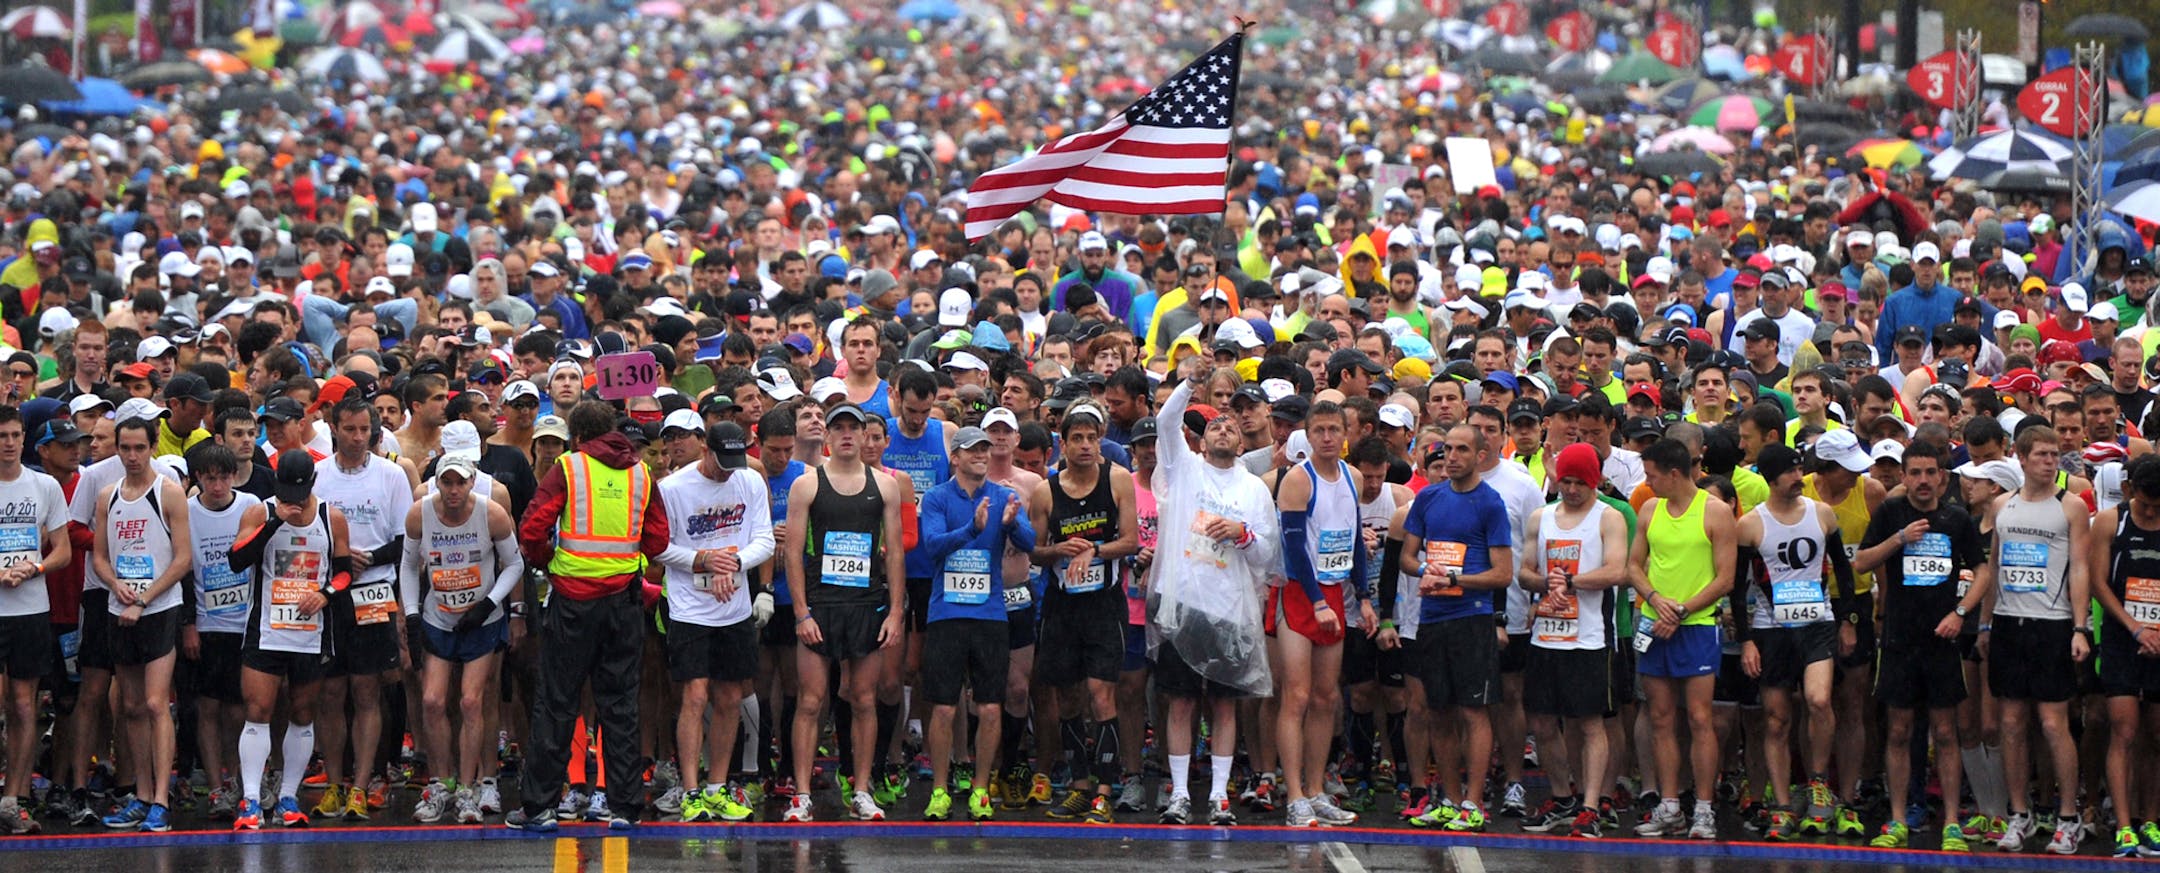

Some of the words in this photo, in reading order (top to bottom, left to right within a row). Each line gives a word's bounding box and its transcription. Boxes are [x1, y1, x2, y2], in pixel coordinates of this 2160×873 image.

[1927, 72, 1944, 99] 3
[2034, 81, 2068, 92] CORRAL
[2041, 93, 2060, 124] 2
[602, 363, 654, 388] 1:30
[115, 519, 148, 530] FLEET
[118, 529, 144, 540] FEET
[431, 531, 478, 541] MARATHON
[2007, 527, 2056, 539] VANDERBILT
[826, 543, 869, 552] NASHVILLE
[831, 559, 863, 573] 1284
[947, 560, 989, 569] NASHVILLE
[1325, 555, 1348, 568] 1649
[1911, 559, 1945, 572] 1586
[952, 576, 984, 590] 1695
[2004, 570, 2044, 584] 15733
[212, 590, 244, 607] 1221
[360, 587, 389, 602] 1067
[442, 591, 475, 605] 1132
[1776, 591, 1820, 599] NASHVILLE
[1783, 606, 1818, 620] 1645
[2132, 605, 2160, 620] 115
[1544, 620, 1571, 632] 1141
